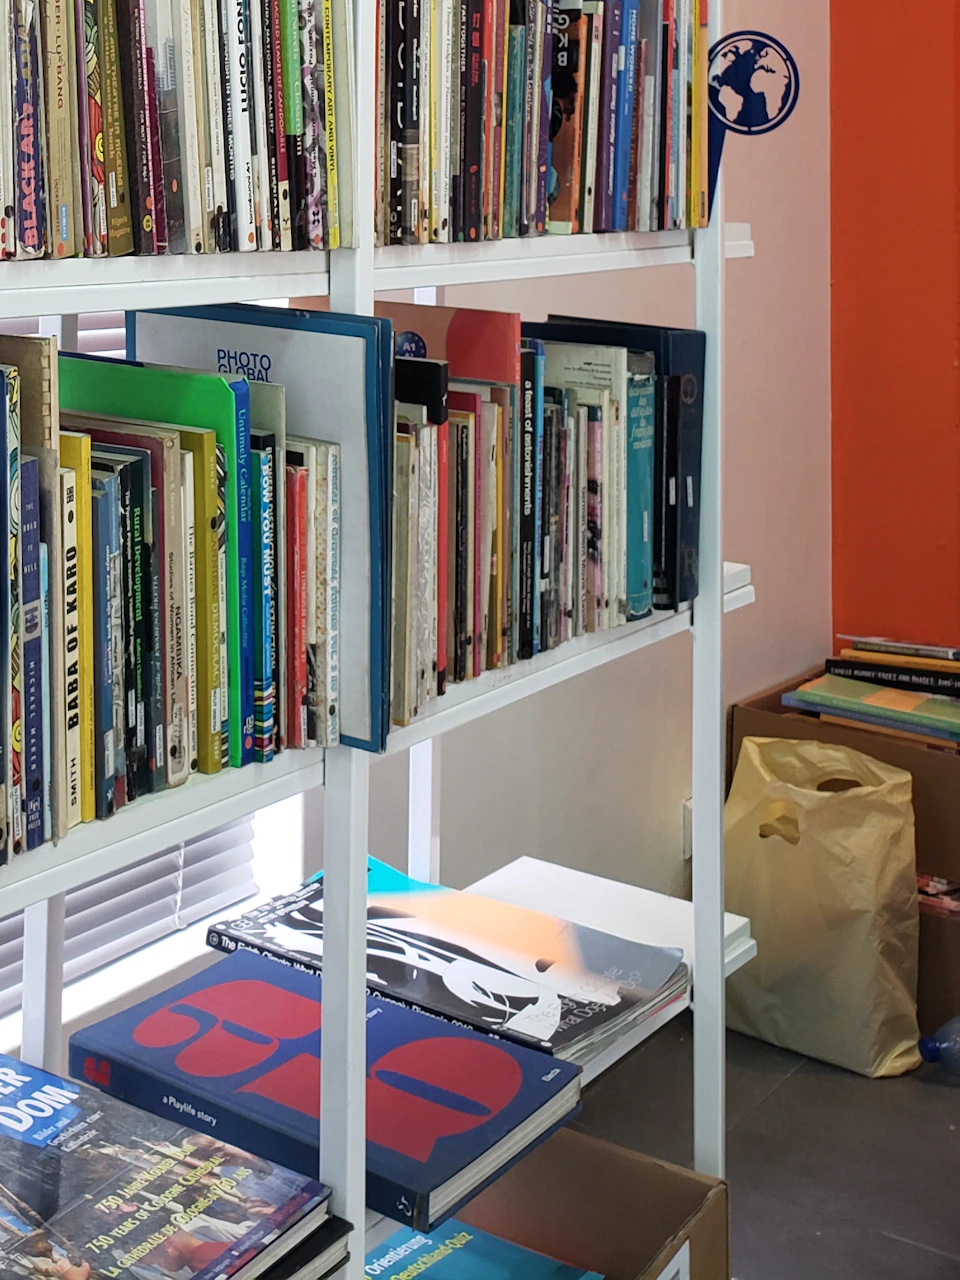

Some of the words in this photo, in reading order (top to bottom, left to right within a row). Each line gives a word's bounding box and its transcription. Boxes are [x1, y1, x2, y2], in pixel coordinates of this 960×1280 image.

[324, 7, 333, 94] CONTEMPORARY
[239, 52, 248, 113] LUCIO
[21, 159, 38, 246] BLACK
[216, 348, 271, 371] PHOTO
[402, 341, 417, 352] A1
[524, 380, 532, 389] a
[524, 390, 532, 419] feast
[238, 408, 247, 465] Untimely
[524, 419, 532, 431] of
[239, 468, 248, 522] Calendar
[524, 433, 532, 515] astonishments
[133, 507, 141, 542] Rural
[66, 546, 77, 615] KARO
[133, 545, 142, 622] Development
[66, 623, 78, 653] OF
[175, 606, 183, 680] NGAMBIKA
[67, 660, 79, 731] BABA
[221, 936, 236, 950] The
[168, 1096, 196, 1116] Playlife
[196, 1111, 218, 1127] story
[365, 1235, 433, 1274] Orientierung
